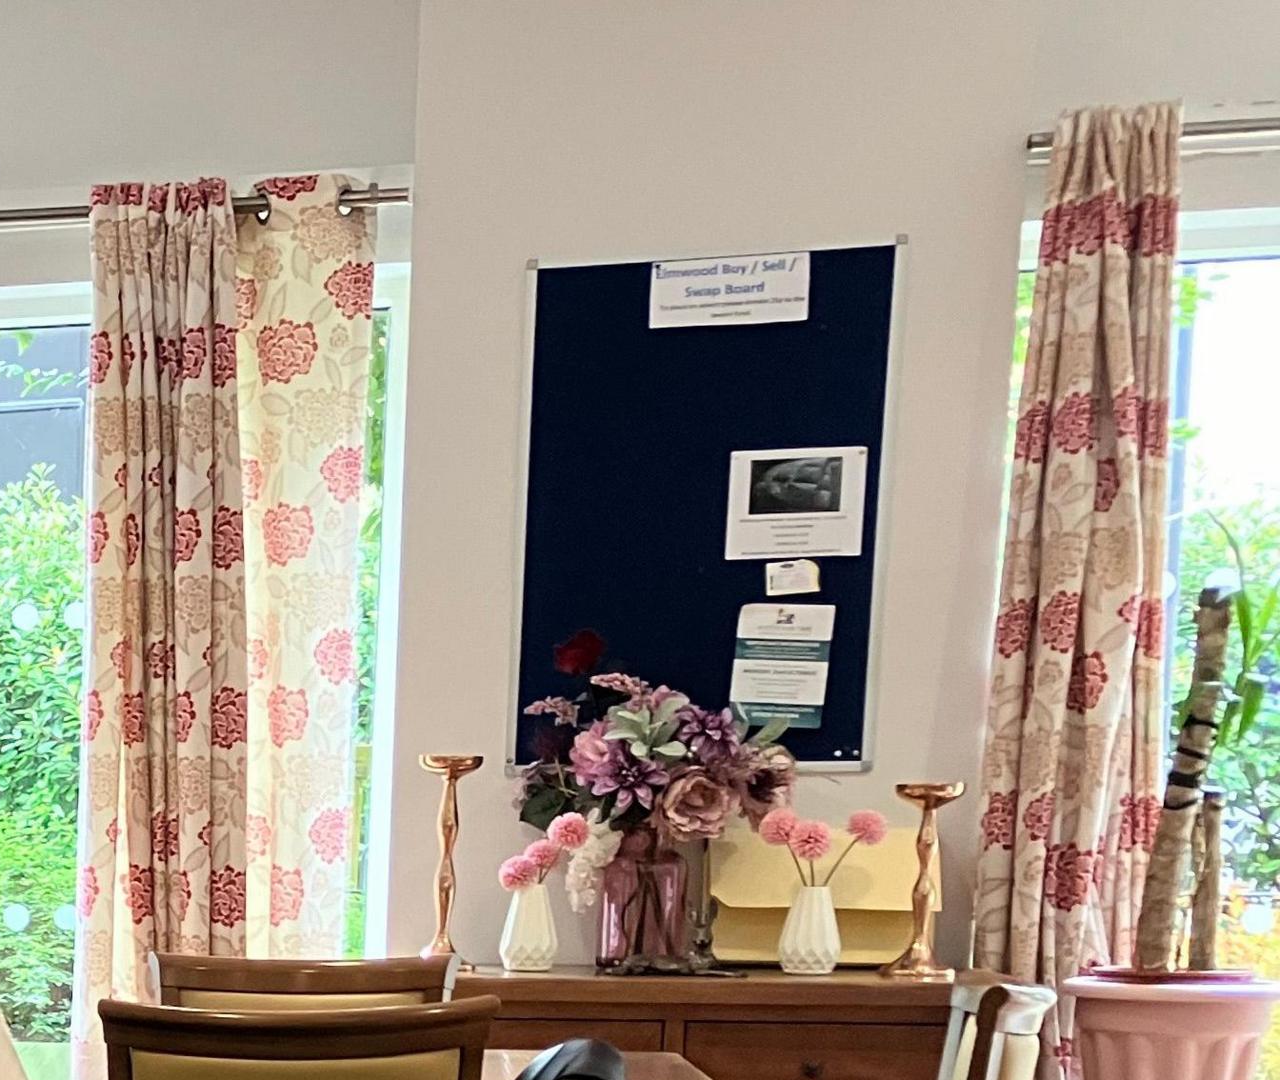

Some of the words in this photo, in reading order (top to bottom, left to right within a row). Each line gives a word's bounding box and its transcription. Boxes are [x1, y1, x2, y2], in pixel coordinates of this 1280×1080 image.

[722, 264, 747, 276] Buy
[751, 261, 758, 275] /
[762, 259, 786, 272] Sell
[685, 286, 721, 298] Swap
[725, 281, 765, 295] Board
